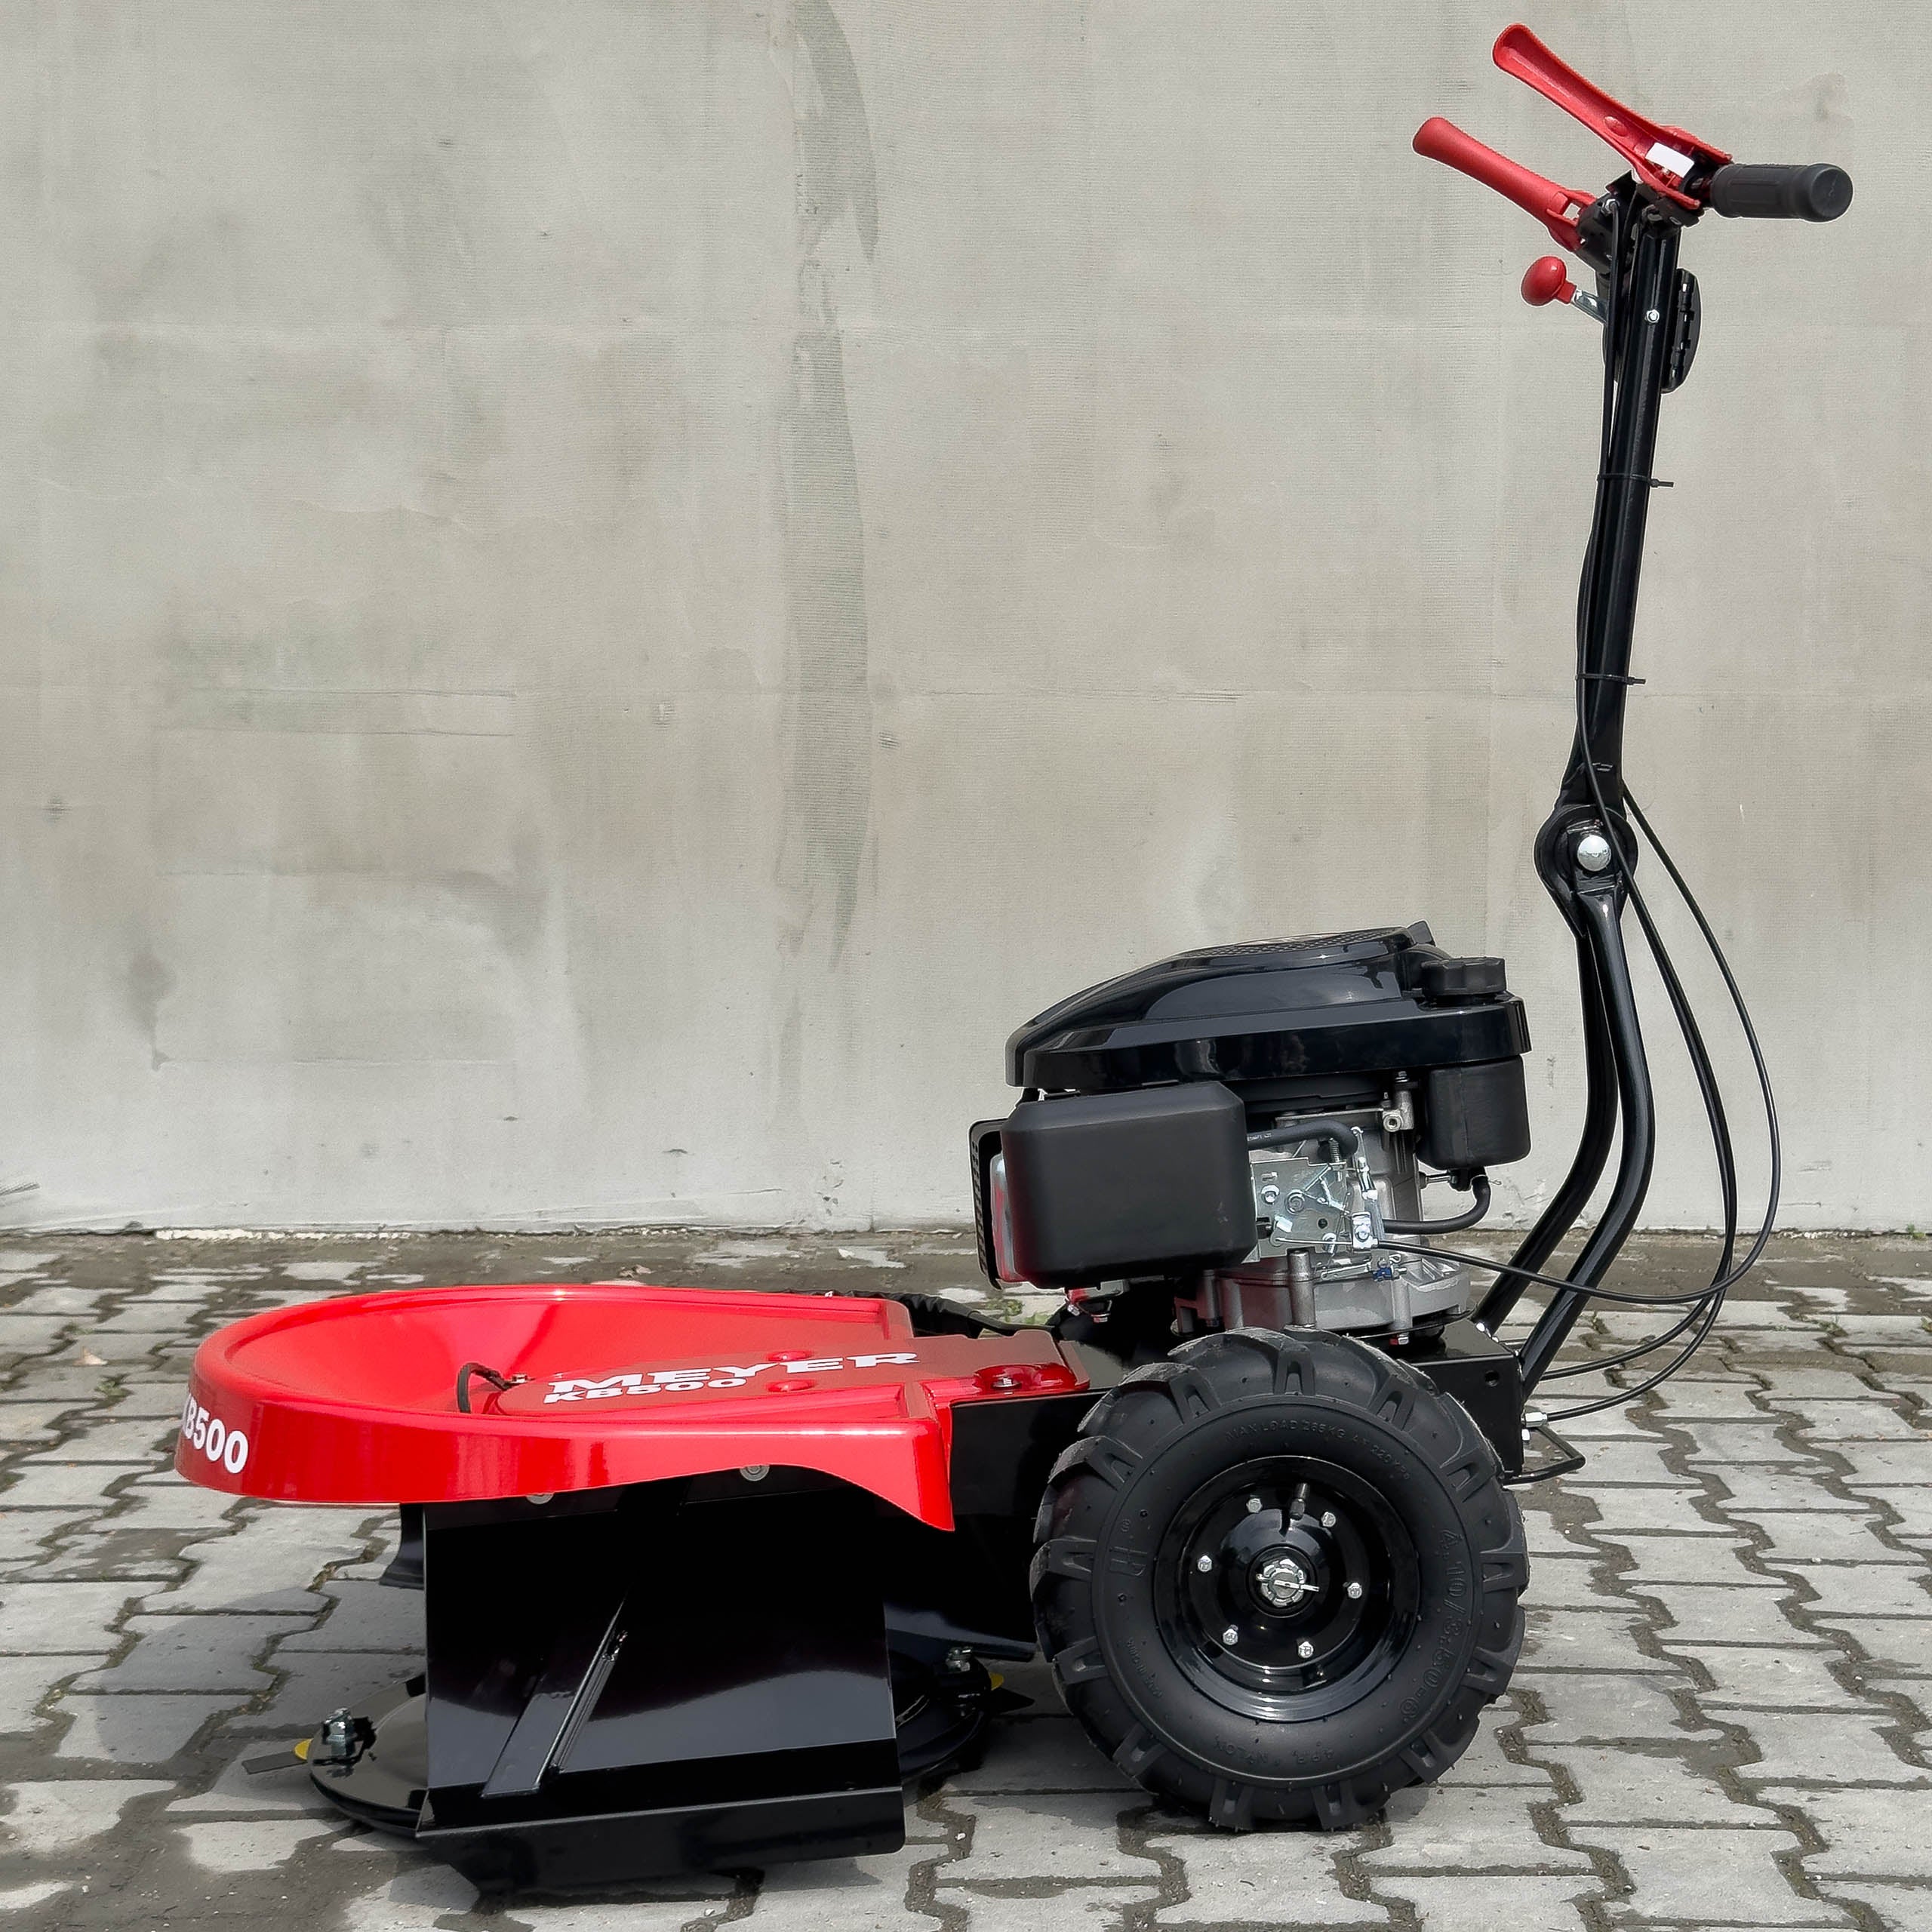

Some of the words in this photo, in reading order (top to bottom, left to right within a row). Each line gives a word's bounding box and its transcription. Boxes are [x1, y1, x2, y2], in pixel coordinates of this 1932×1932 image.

[549, 1352, 920, 1393] MEYER
[543, 1377, 748, 1404] KB500
[183, 1393, 249, 1474] B500
[1225, 1423, 1257, 1441] MAX
[1261, 1418, 1298, 1432] LOAD
